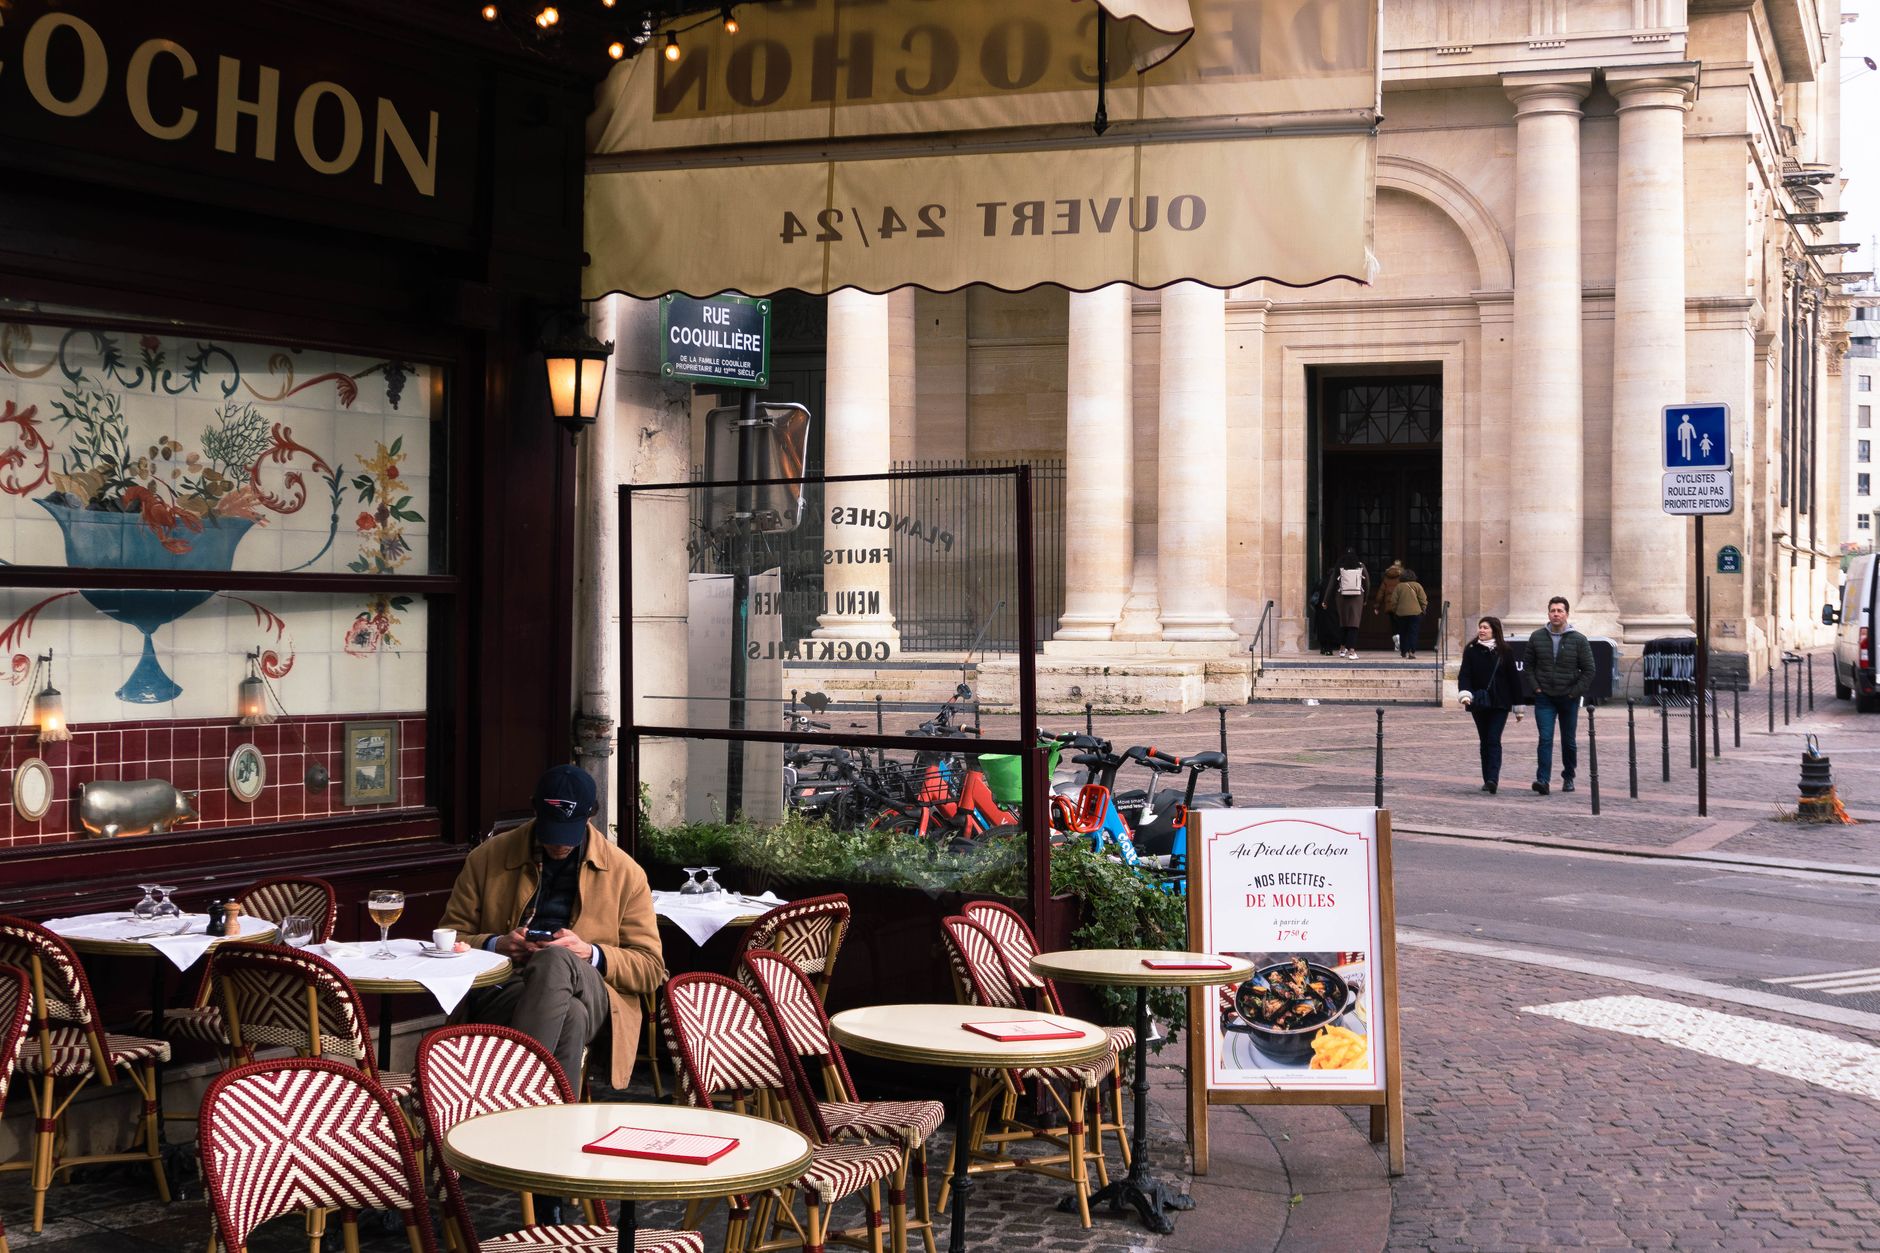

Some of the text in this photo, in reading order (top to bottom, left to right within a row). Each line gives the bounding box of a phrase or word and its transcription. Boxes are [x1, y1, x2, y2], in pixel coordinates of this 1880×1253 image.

[0, 12, 439, 197] OCHON
[703, 306, 730, 325] RUE
[670, 326, 761, 352] COQUILLIÈRE
[699, 357, 719, 365] FAMILLE
[722, 359, 751, 368] COQUILLIER
[715, 366, 722, 374] AU
[1676, 474, 1716, 484] CYCLISTES
[1668, 486, 1724, 496] ROULEZ AU PAS
[1229, 842, 1349, 859] Au Pied de Cochon
[1254, 872, 1326, 889] NOS RECETTES
[1246, 893, 1336, 908] DE MOULES
[1279, 918, 1300, 927] partir
